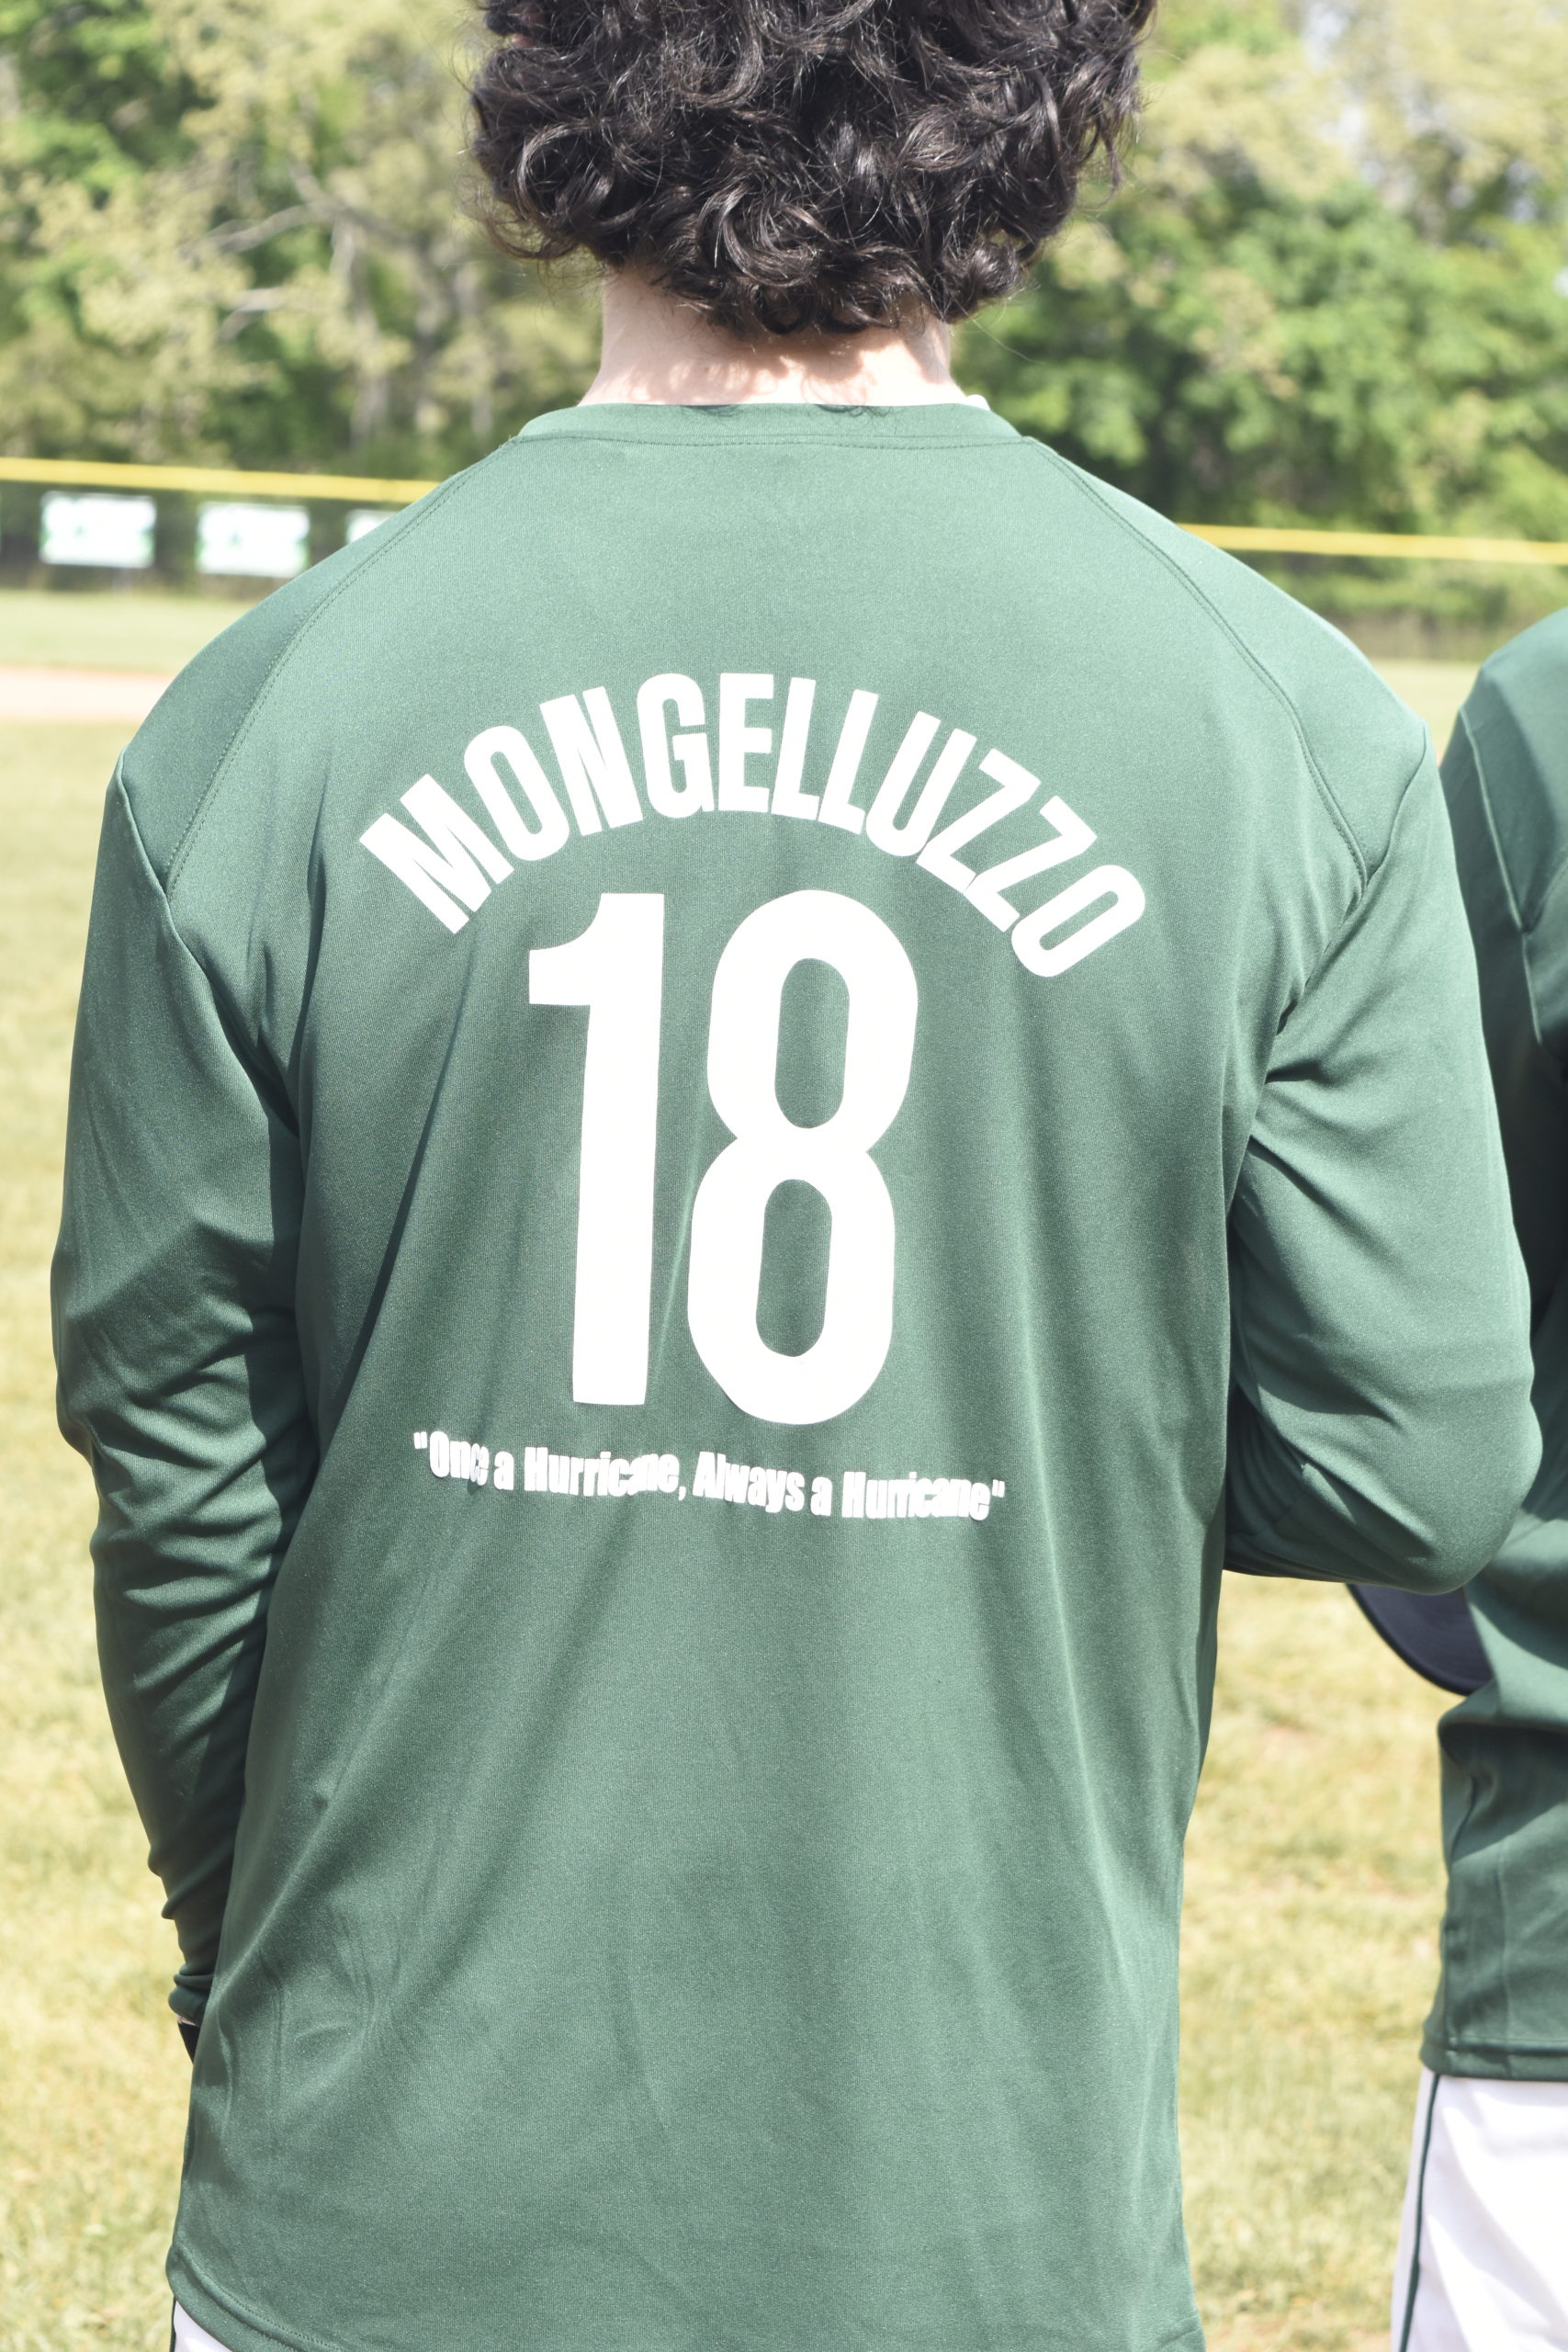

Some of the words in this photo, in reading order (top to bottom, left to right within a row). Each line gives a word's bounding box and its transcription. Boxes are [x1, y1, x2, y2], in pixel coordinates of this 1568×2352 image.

[359, 673, 1146, 977] MONGELLUZZO
[528, 889, 919, 1426] 18
[493, 1451, 514, 1490] a
[693, 1451, 806, 1513] Always
[810, 1476, 832, 1516] a
[841, 1471, 1006, 1521] Hurricane"
